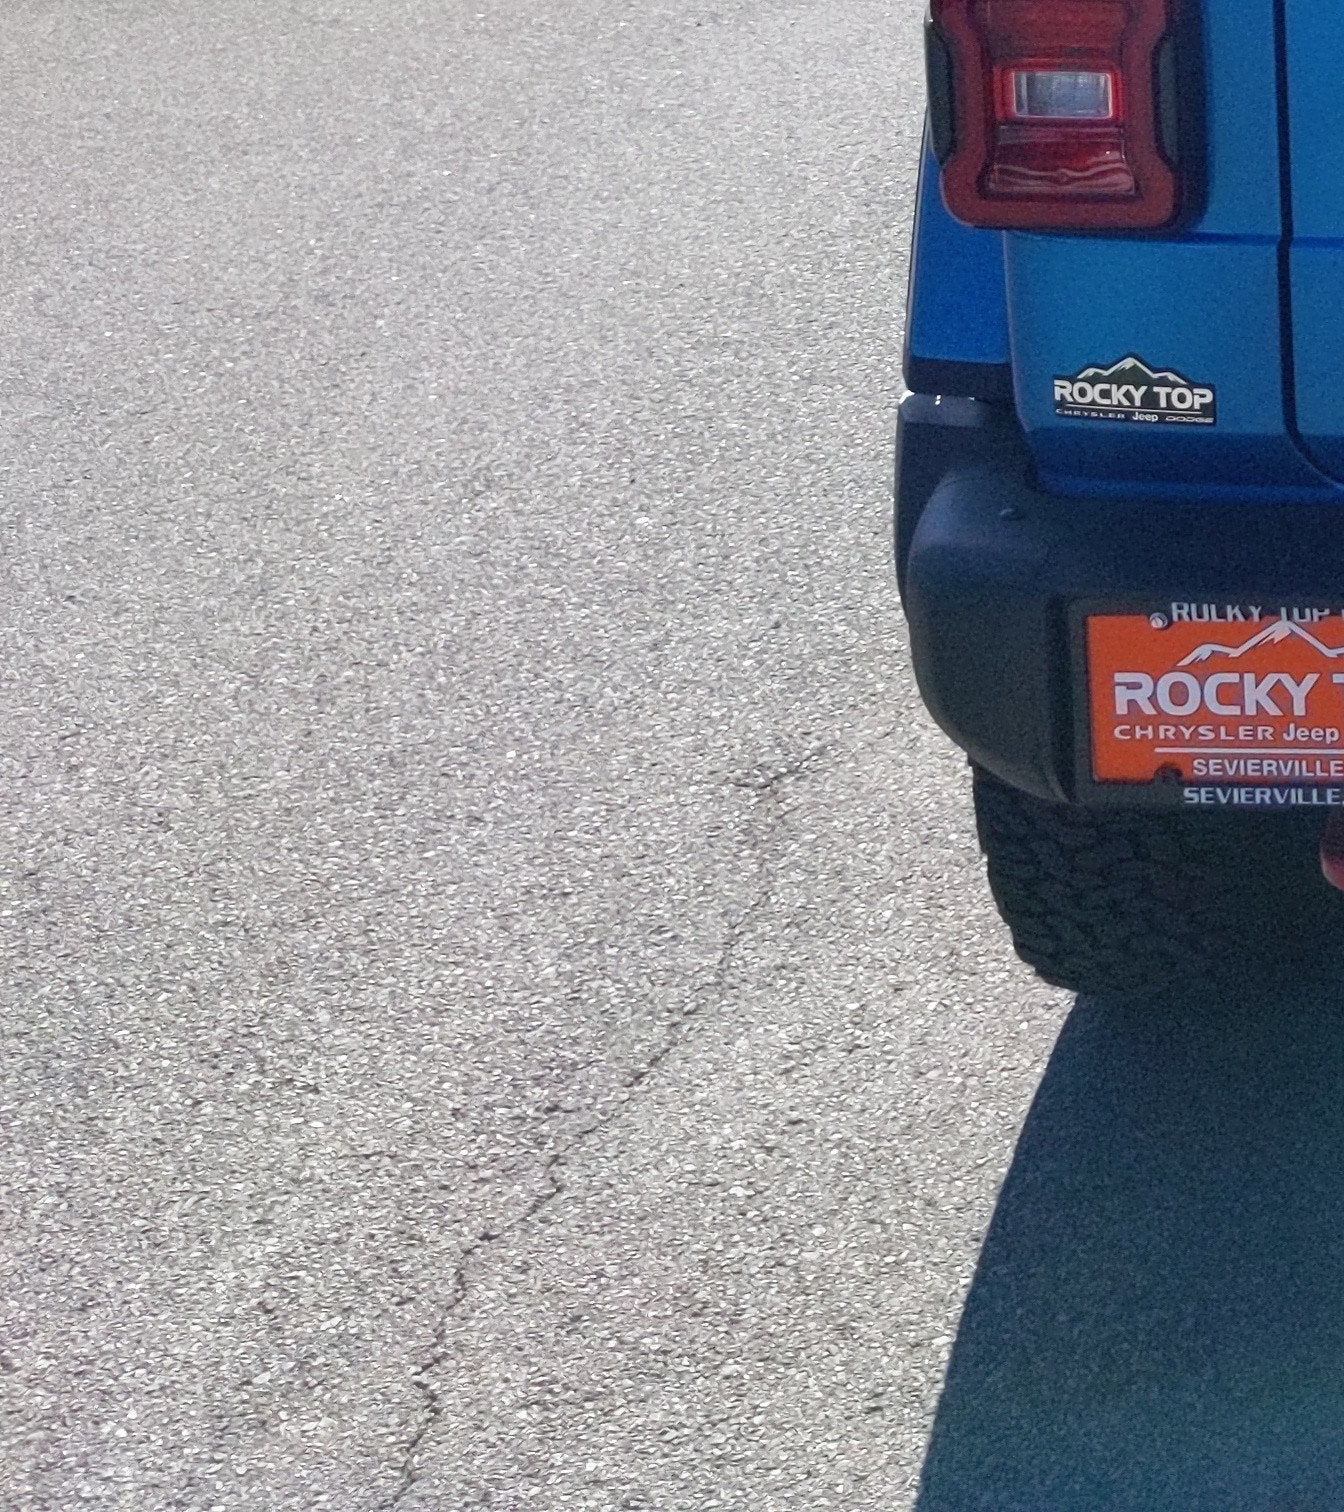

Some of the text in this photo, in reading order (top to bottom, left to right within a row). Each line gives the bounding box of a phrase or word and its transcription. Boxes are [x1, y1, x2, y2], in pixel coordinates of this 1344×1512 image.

[1053, 379, 1214, 410] ROCKY TOP
[1056, 408, 1126, 419] CHRYSLER
[1132, 411, 1159, 422] Jeep
[1113, 672, 1321, 717] ROCKY
[1113, 724, 1275, 741] CHRYSLER
[1283, 722, 1340, 743] Jeep
